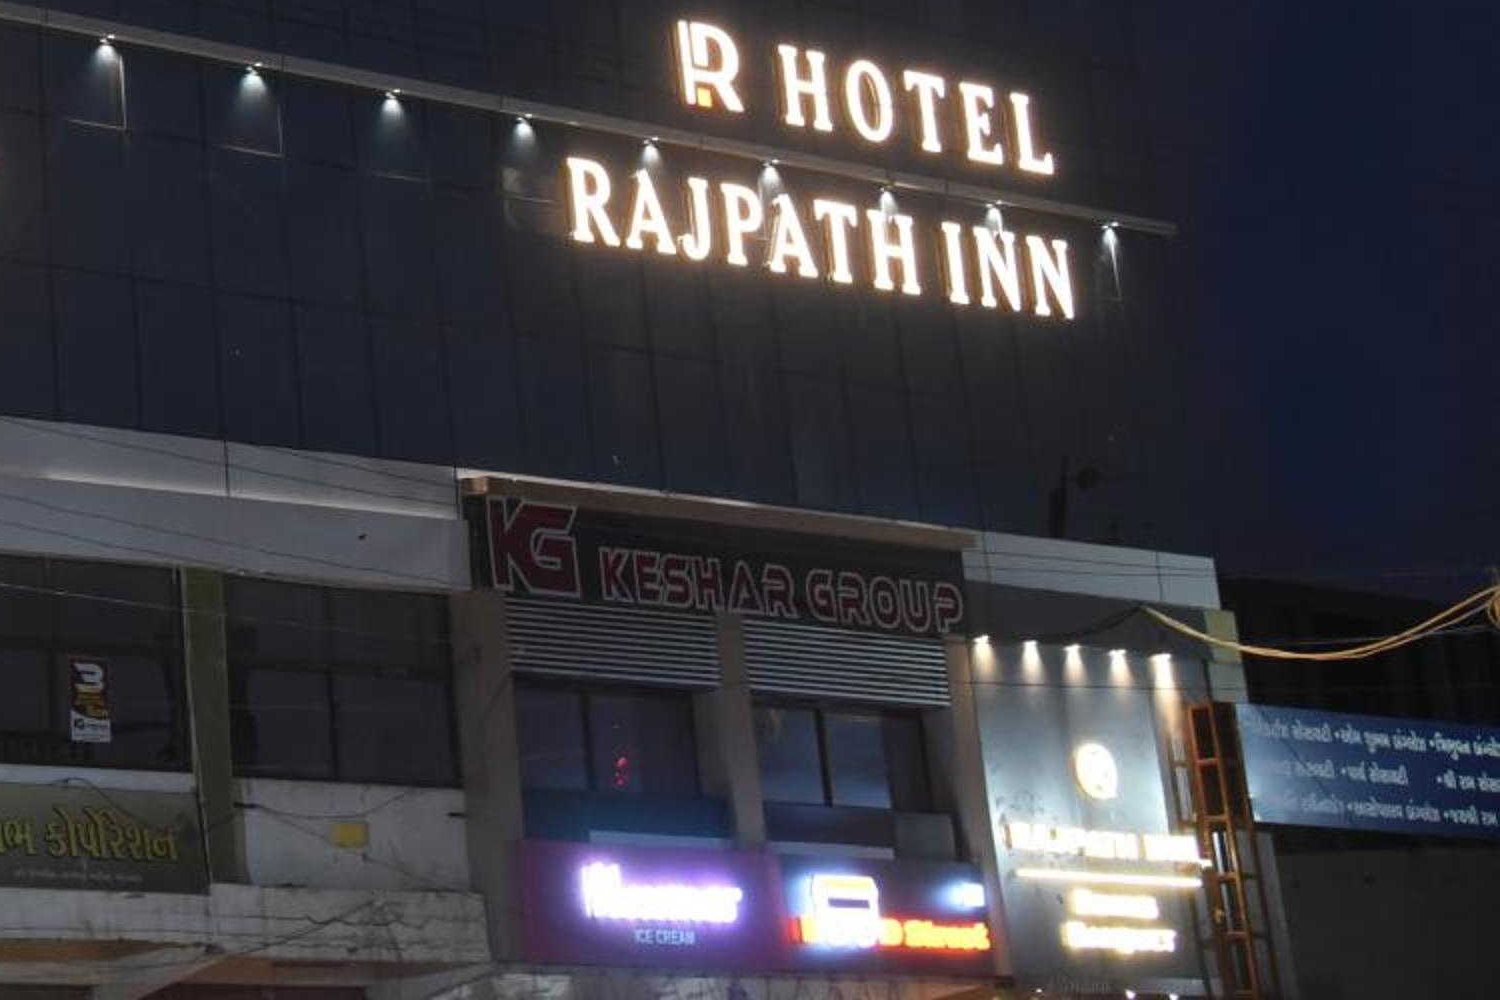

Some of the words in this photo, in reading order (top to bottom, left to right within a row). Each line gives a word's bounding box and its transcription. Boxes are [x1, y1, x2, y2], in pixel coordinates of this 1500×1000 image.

[776, 43, 1055, 176] HOTEL
[565, 156, 922, 295] RAJPATH
[940, 221, 1076, 320] INN
[486, 495, 582, 600] KG
[597, 546, 799, 619] KESHAR
[804, 567, 965, 634] GROUP
[634, 928, 654, 944] ICE
[655, 930, 695, 946] CREAM
